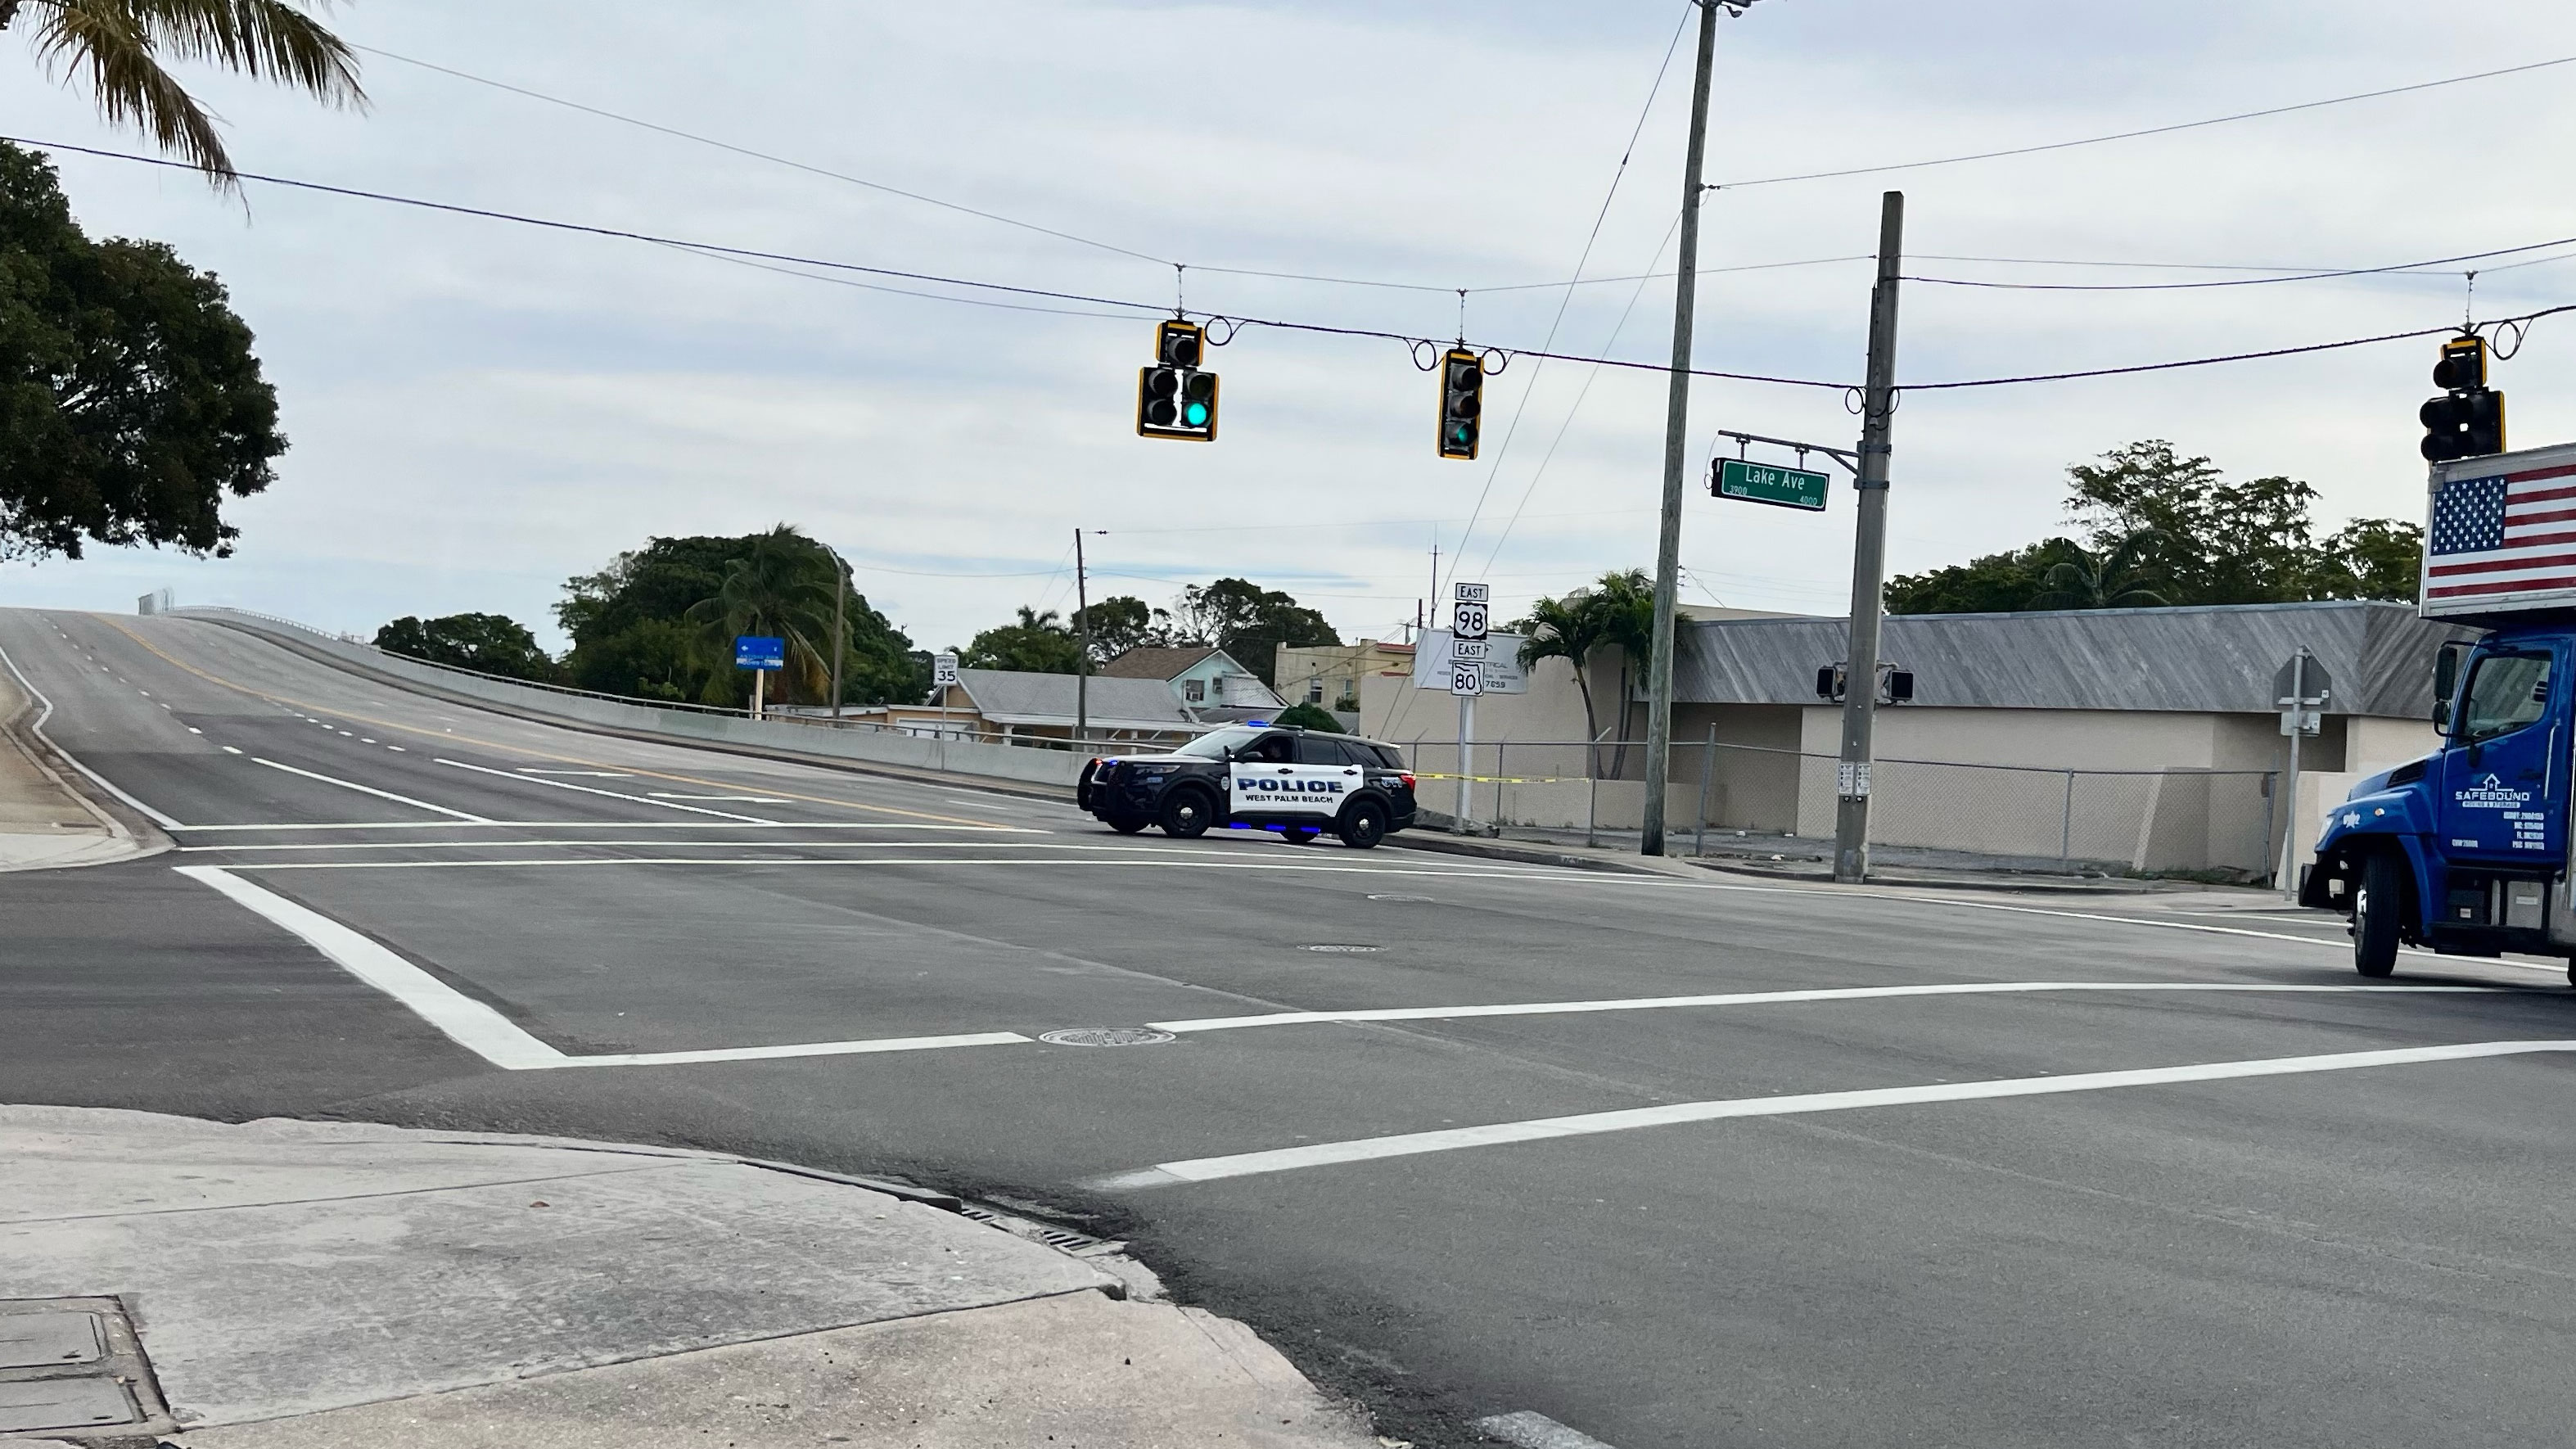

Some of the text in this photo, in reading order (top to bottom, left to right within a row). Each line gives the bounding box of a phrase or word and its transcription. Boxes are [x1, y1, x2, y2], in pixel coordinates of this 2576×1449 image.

[1746, 466, 1804, 490] Lake Ave
[1730, 485, 1748, 495] 3900
[1460, 585, 1482, 598] EAST
[1459, 611, 1483, 631] 98
[1459, 643, 1481, 656] EAST
[937, 670, 956, 682] 35
[1455, 674, 1476, 690] 80
[1237, 778, 1345, 793] POLICE
[1302, 796, 1333, 804] BEACH
[2456, 791, 2531, 801] SAFEBOUND
